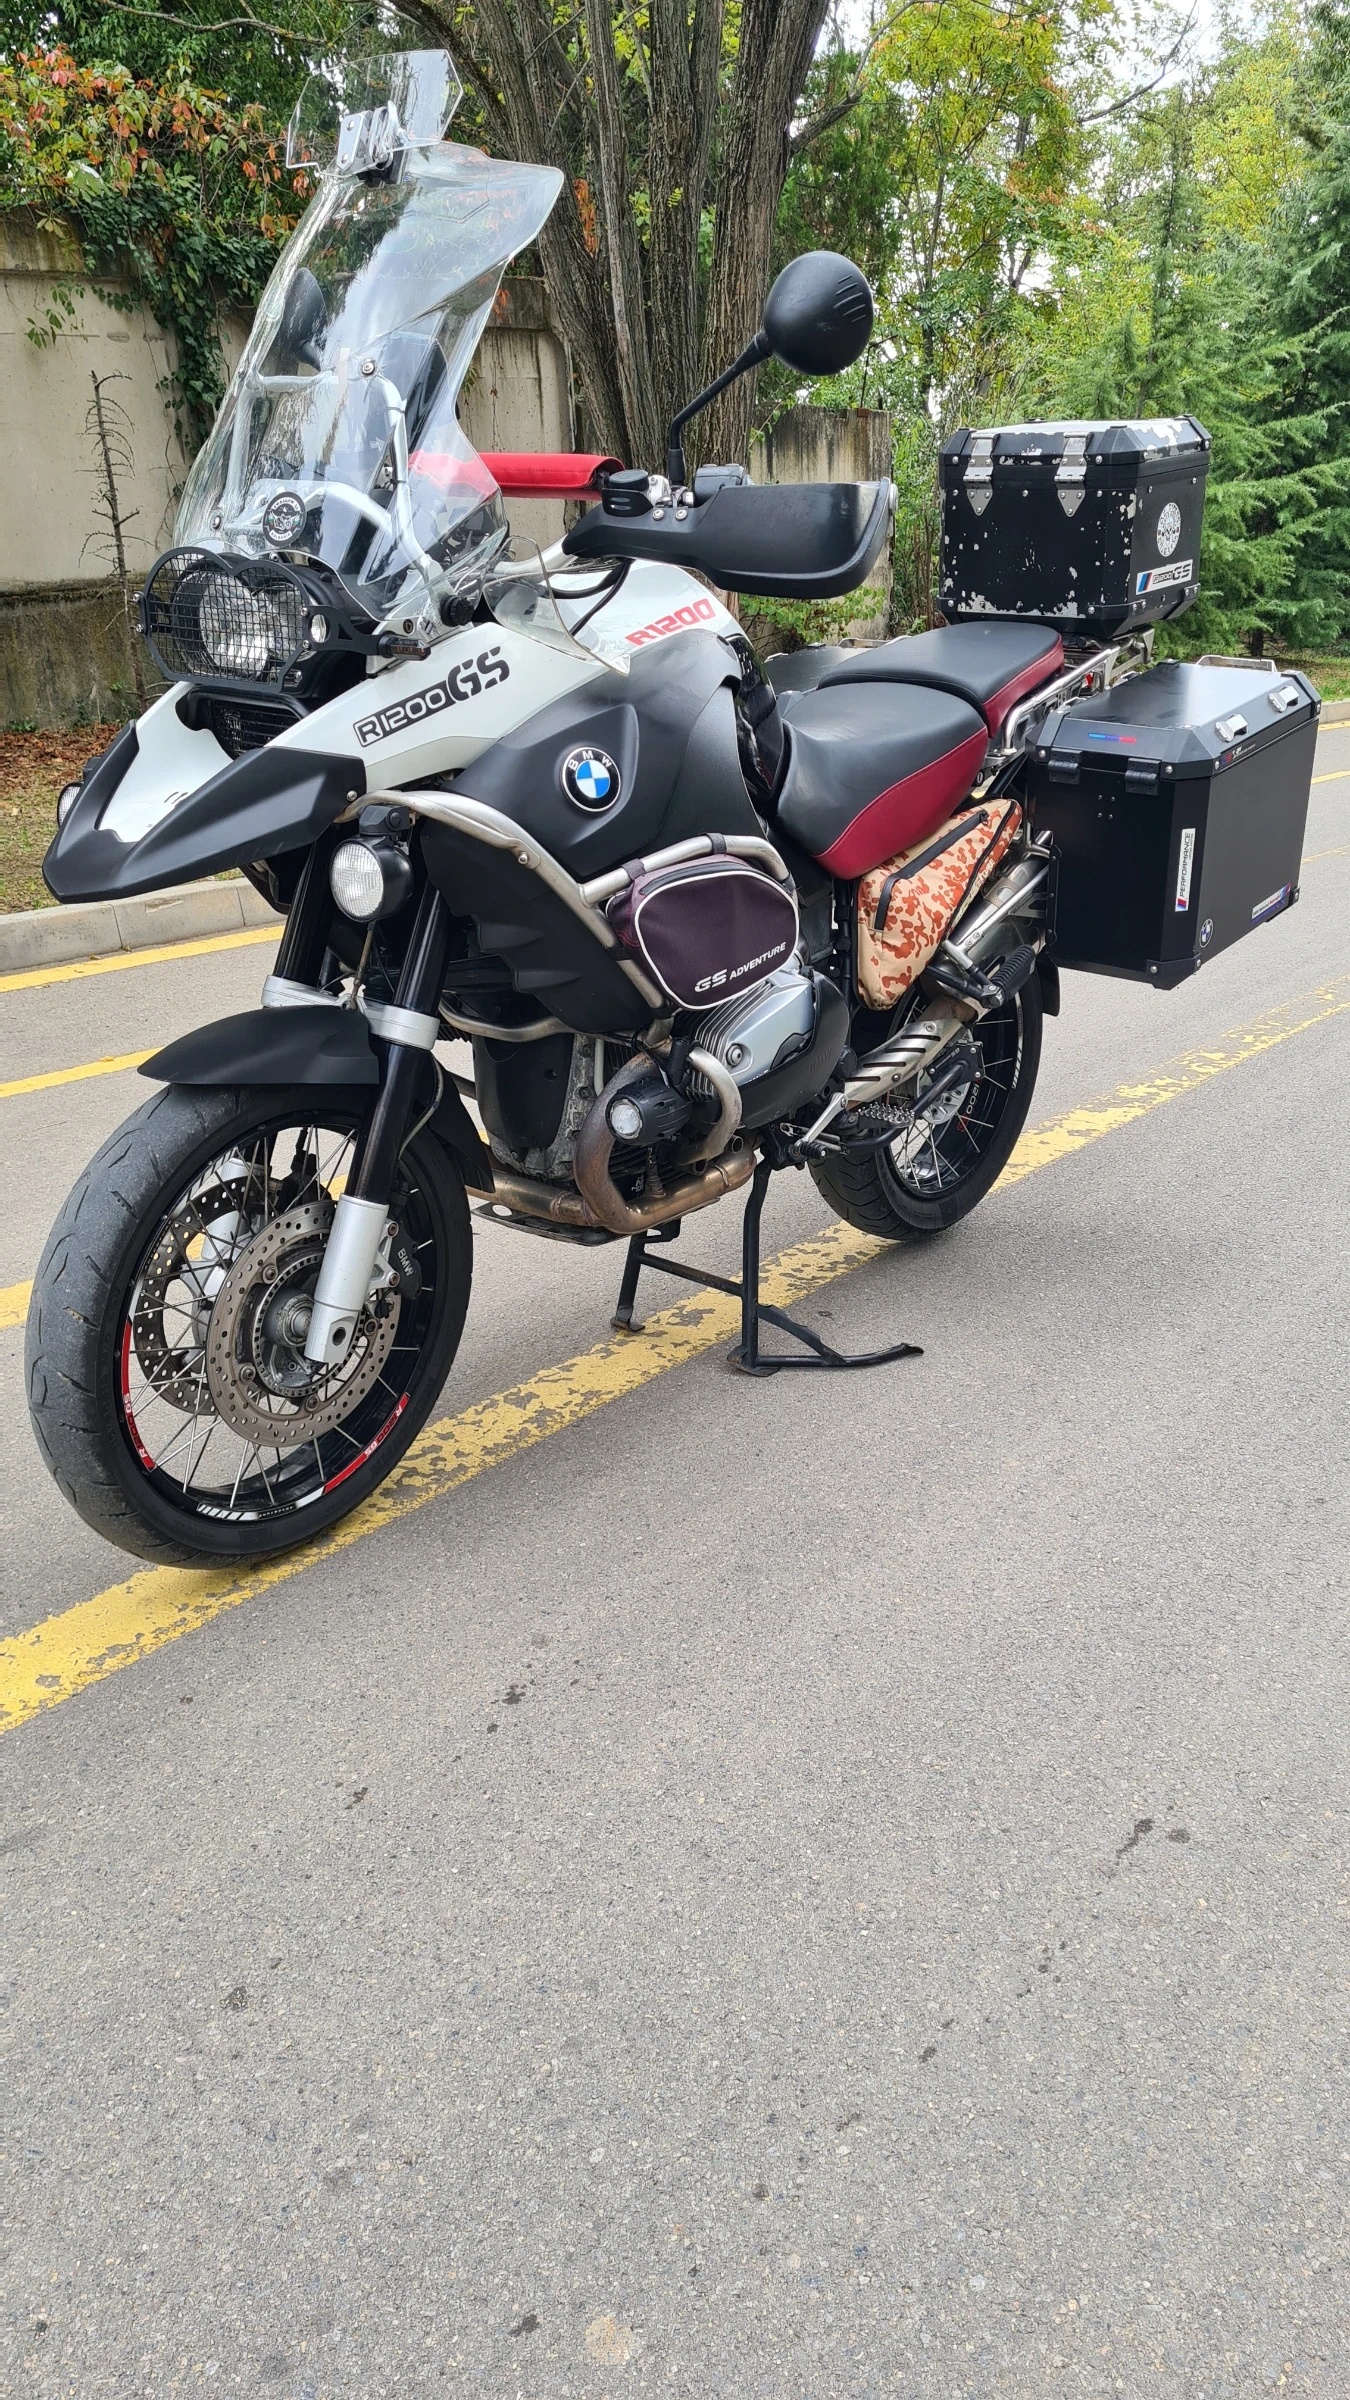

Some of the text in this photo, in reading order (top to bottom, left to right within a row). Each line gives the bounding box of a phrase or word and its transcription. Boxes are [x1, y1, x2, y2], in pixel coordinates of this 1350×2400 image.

[625, 598, 716, 646] R1200
[568, 750, 612, 771] BMW
[1180, 832, 1191, 897] PERFORMANCE
[695, 941, 787, 993] GS ADVENTURE
[397, 1248, 414, 1276] BMW
